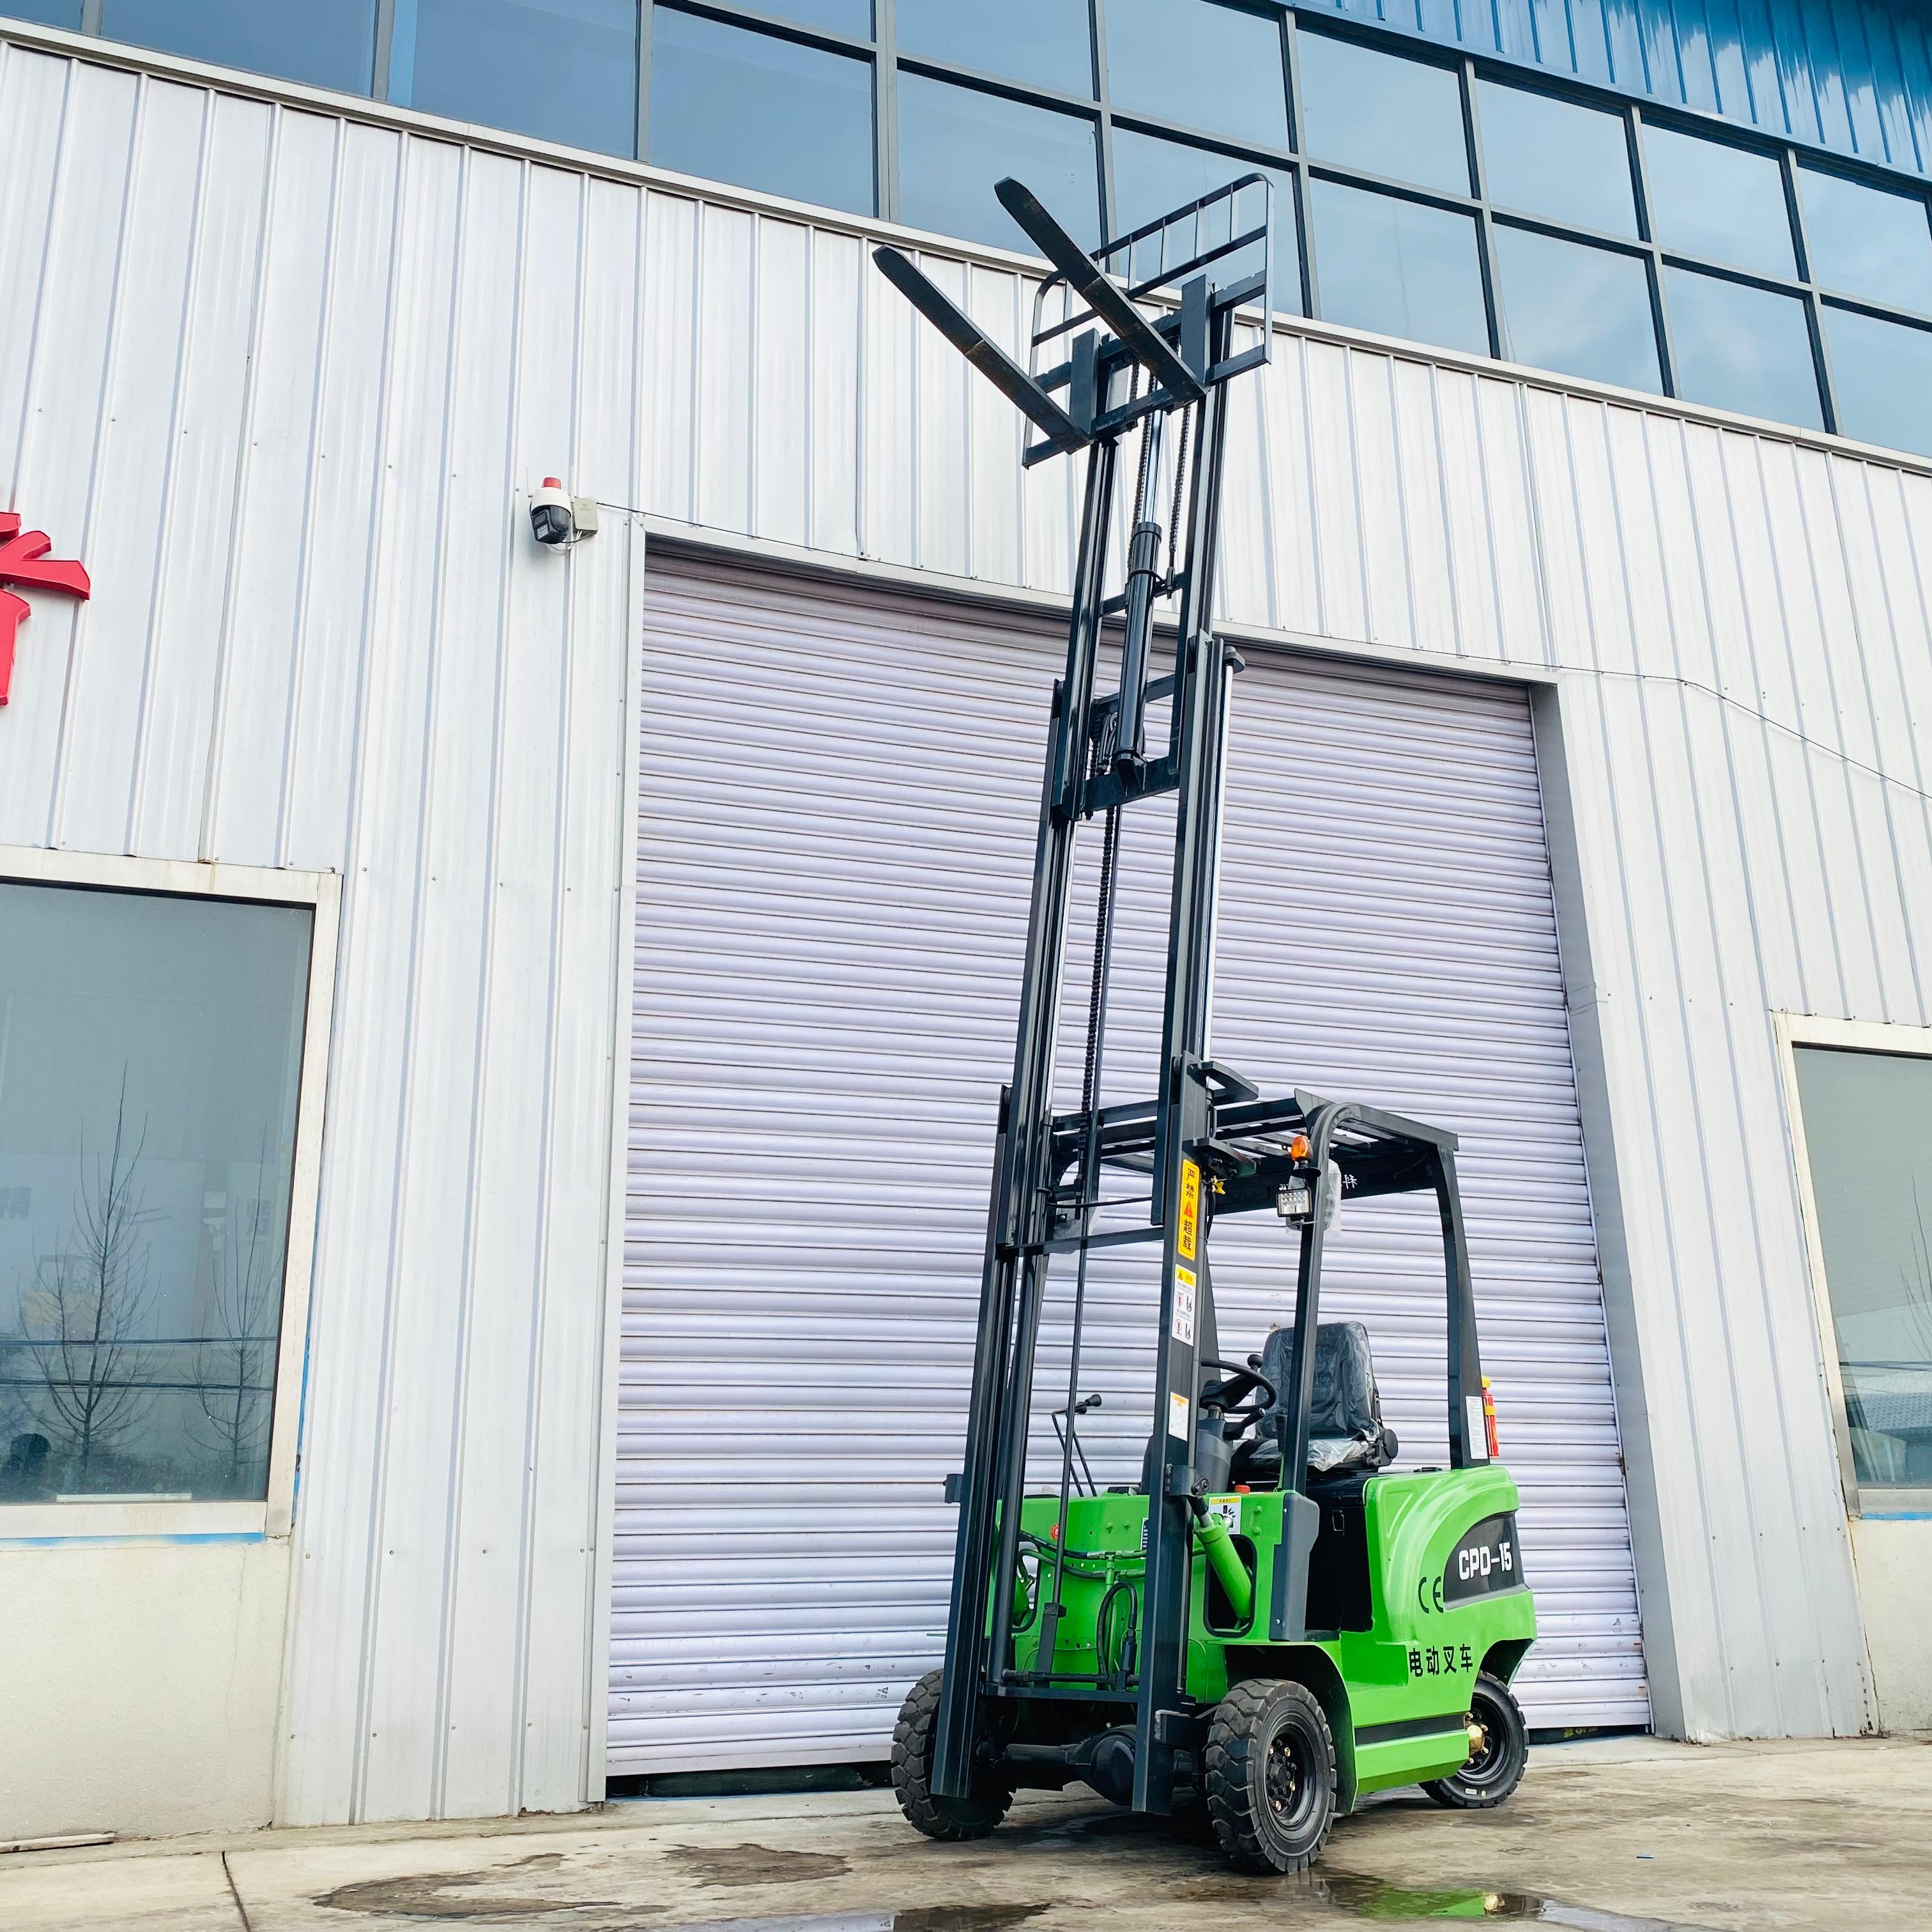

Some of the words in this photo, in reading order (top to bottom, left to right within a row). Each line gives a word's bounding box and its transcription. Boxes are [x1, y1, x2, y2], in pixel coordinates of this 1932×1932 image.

[1459, 1542, 1512, 1581] CPD-15
[1418, 1575, 1444, 1614] CE
[1409, 1643, 1473, 1677] 电动叉车
